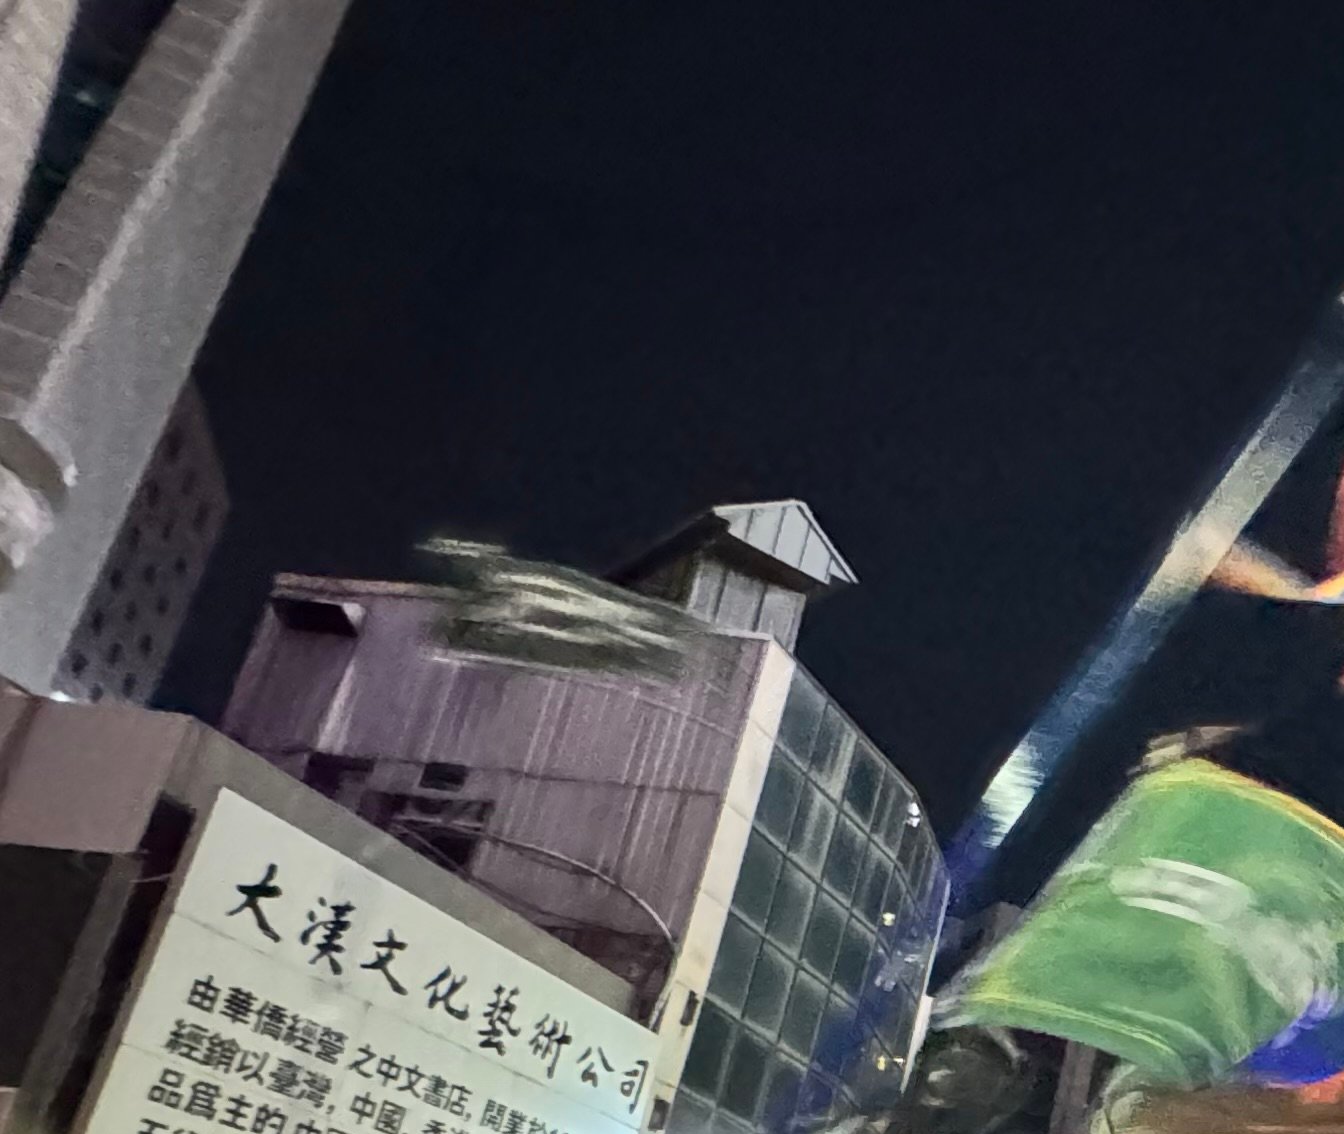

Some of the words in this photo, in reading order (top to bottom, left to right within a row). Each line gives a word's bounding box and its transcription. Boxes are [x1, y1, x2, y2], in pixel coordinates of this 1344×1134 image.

[226, 862, 651, 1115] 大漢文化藝術公司
